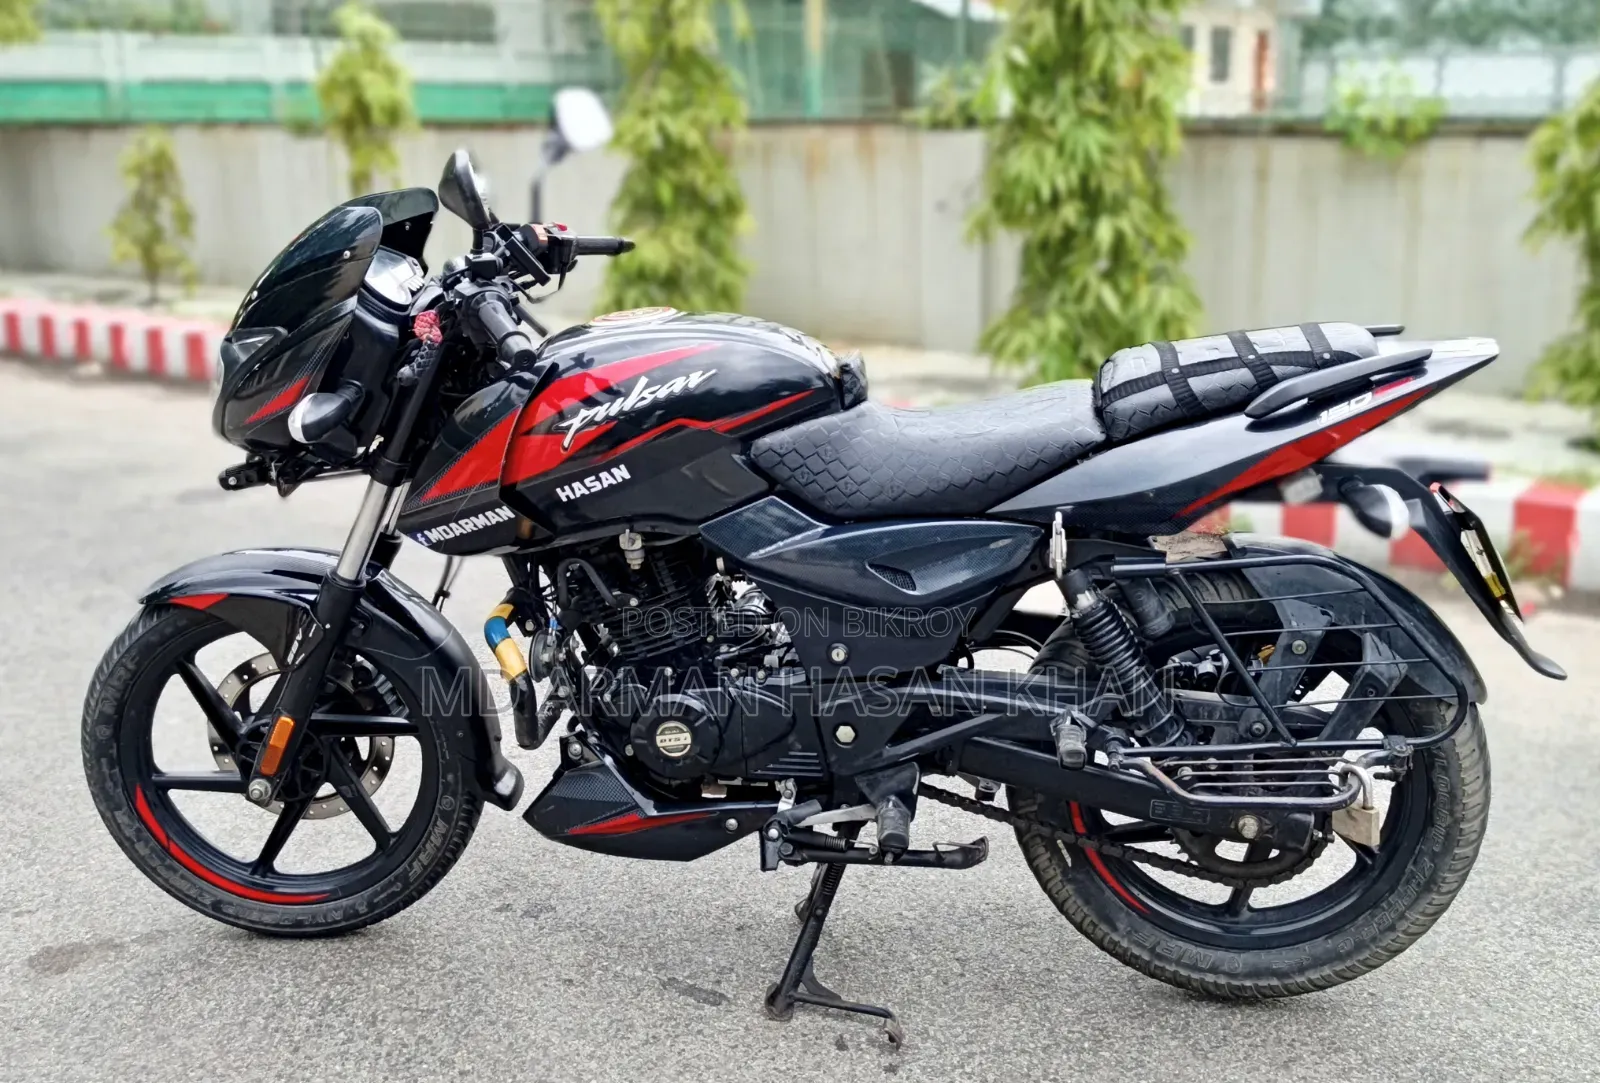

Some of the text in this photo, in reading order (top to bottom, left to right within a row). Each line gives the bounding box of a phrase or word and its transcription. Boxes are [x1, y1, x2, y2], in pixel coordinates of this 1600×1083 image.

[555, 463, 632, 502] HASAN
[423, 505, 516, 543] MDARMAN
[409, 816, 449, 883] MRF
